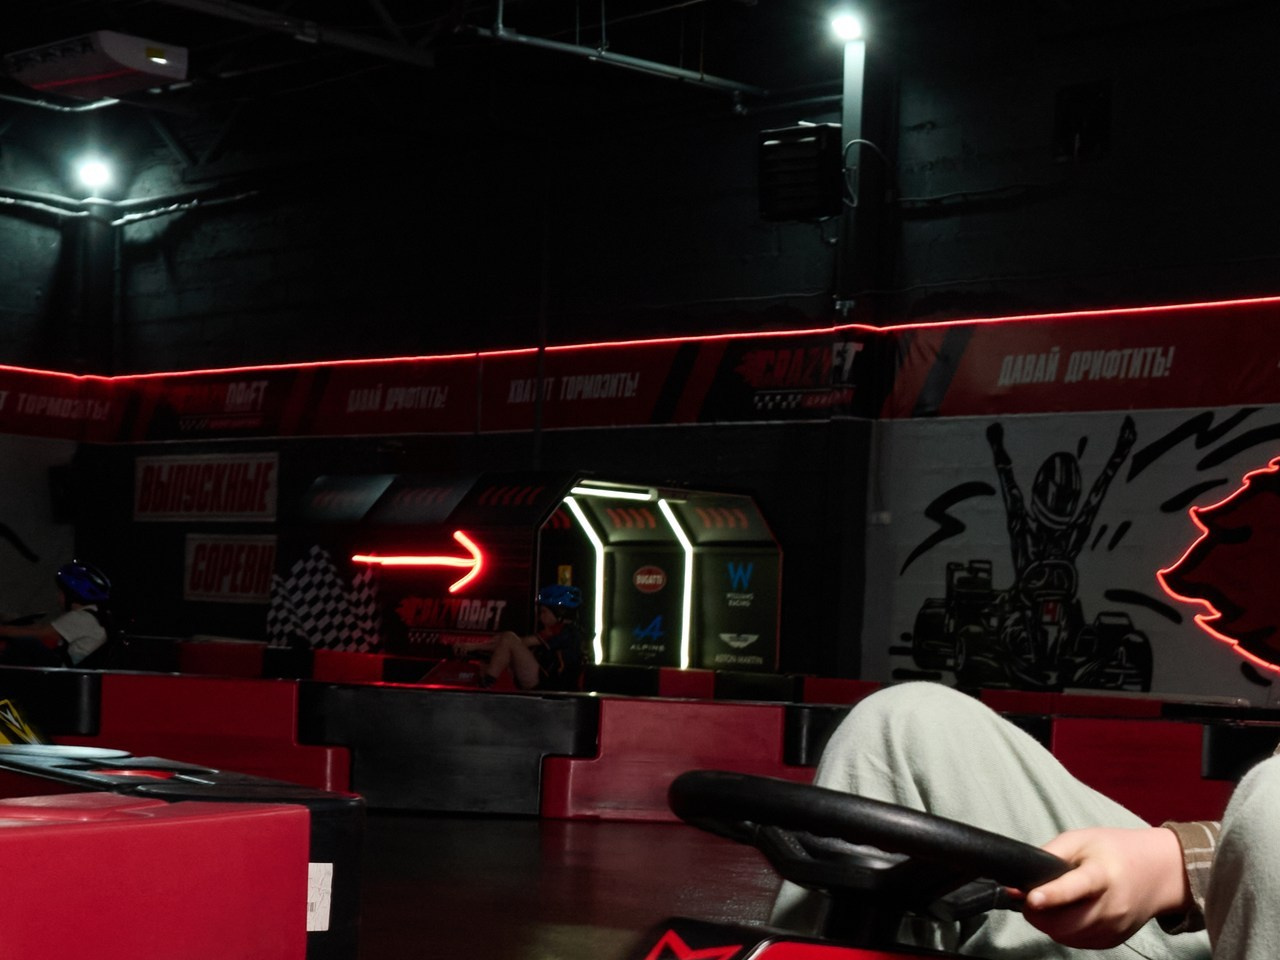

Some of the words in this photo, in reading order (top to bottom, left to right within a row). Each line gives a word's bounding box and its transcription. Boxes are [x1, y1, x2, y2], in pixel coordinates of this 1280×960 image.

[997, 346, 1061, 388] ДАВАЙ
[1063, 345, 1176, 384] ДРИФТИТЬ!
[138, 462, 274, 513] ВЫПУСКНЫЕ
